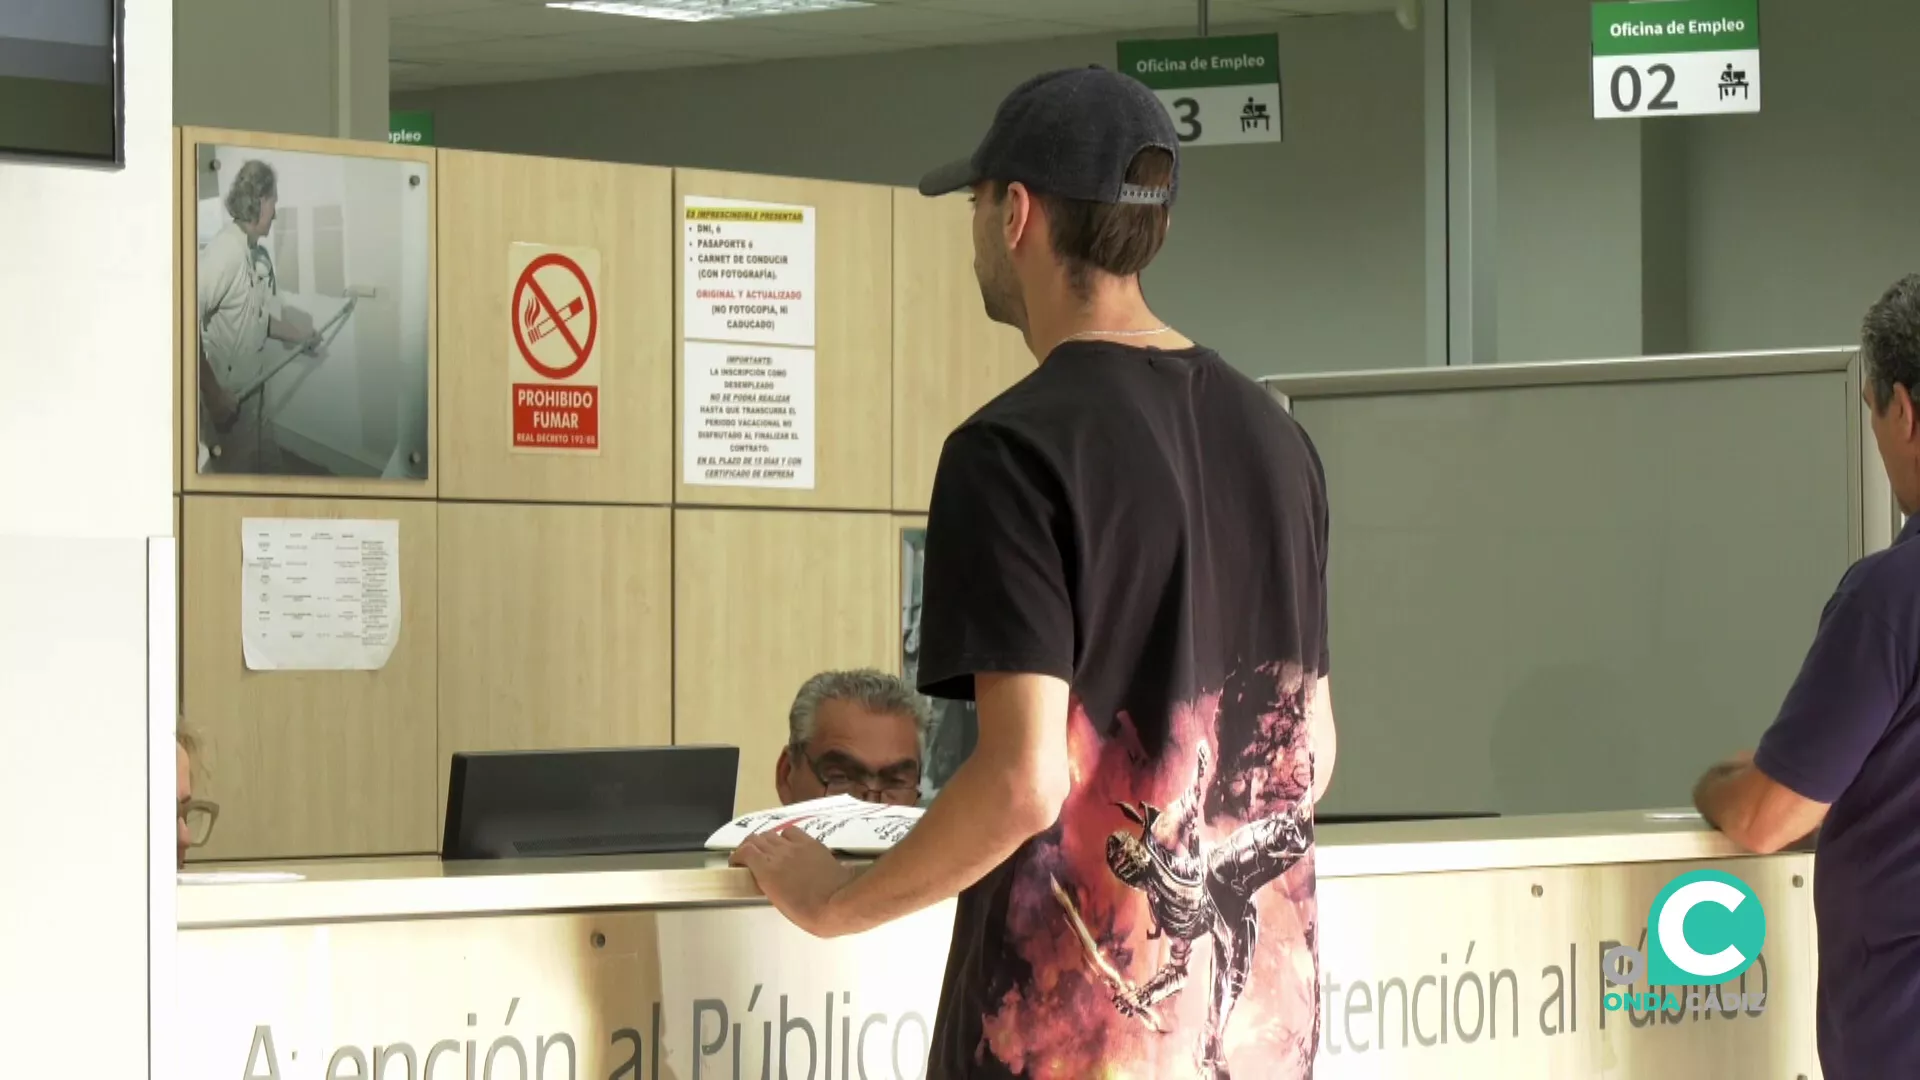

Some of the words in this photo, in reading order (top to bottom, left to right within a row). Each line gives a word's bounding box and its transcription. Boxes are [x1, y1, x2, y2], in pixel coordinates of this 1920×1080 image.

[1610, 21, 1663, 37] Oficina
[1667, 20, 1685, 34] de
[1688, 17, 1745, 36] Empleo
[1136, 58, 1187, 73] Oficina
[1190, 56, 1208, 70] de
[1211, 54, 1265, 71] Empleo
[1610, 63, 1678, 112] 02
[1172, 97, 1202, 142] 3
[388, 128, 422, 144] pleo
[697, 210, 758, 221] IMPRESCINDIBLE
[697, 224, 714, 234] DNI,
[697, 239, 746, 249] PASAPORTE
[698, 255, 731, 264] CARNET
[733, 255, 744, 264] DE
[746, 255, 788, 265] CONDUCIR
[698, 269, 718, 280] (CON
[696, 289, 735, 298] ORIGINAL
[738, 289, 744, 299] Y
[746, 289, 802, 300] ACTUALIZADO
[711, 305, 726, 315] (NO
[780, 306, 788, 314] NI
[726, 319, 775, 331] CADUCADO)
[710, 368, 718, 376] LA
[720, 368, 765, 377] INSCRIPCIÓN
[767, 369, 787, 378] COMO
[724, 381, 774, 390] DESEMPLEADO
[518, 389, 593, 408] PROHIBIDO
[710, 393, 721, 401] NO
[722, 393, 731, 401] SE
[758, 394, 790, 403] REALIZAR
[699, 406, 723, 414] HASTA
[725, 406, 740, 415] QUE
[742, 407, 787, 415] TRANSCURRA
[533, 411, 579, 428] FUMAR
[738, 419, 781, 428] VACACIONAL
[782, 420, 792, 428] NO
[516, 433, 534, 442] REAL
[536, 433, 568, 444] DECRETO
[698, 431, 742, 440] DISFRUTADO
[744, 432, 752, 440] AL
[754, 432, 789, 441] FINALIZAR
[697, 457, 707, 465] EN
[708, 457, 717, 465] EL
[718, 457, 742, 466] PLAZO
[743, 457, 752, 466] DE
[787, 458, 802, 467] CON
[705, 469, 751, 478] CERTIFICADO
[752, 469, 761, 478] DE
[763, 470, 794, 479] EMPRESA
[1321, 940, 1520, 1055] tención
[1539, 942, 1577, 1037] al
